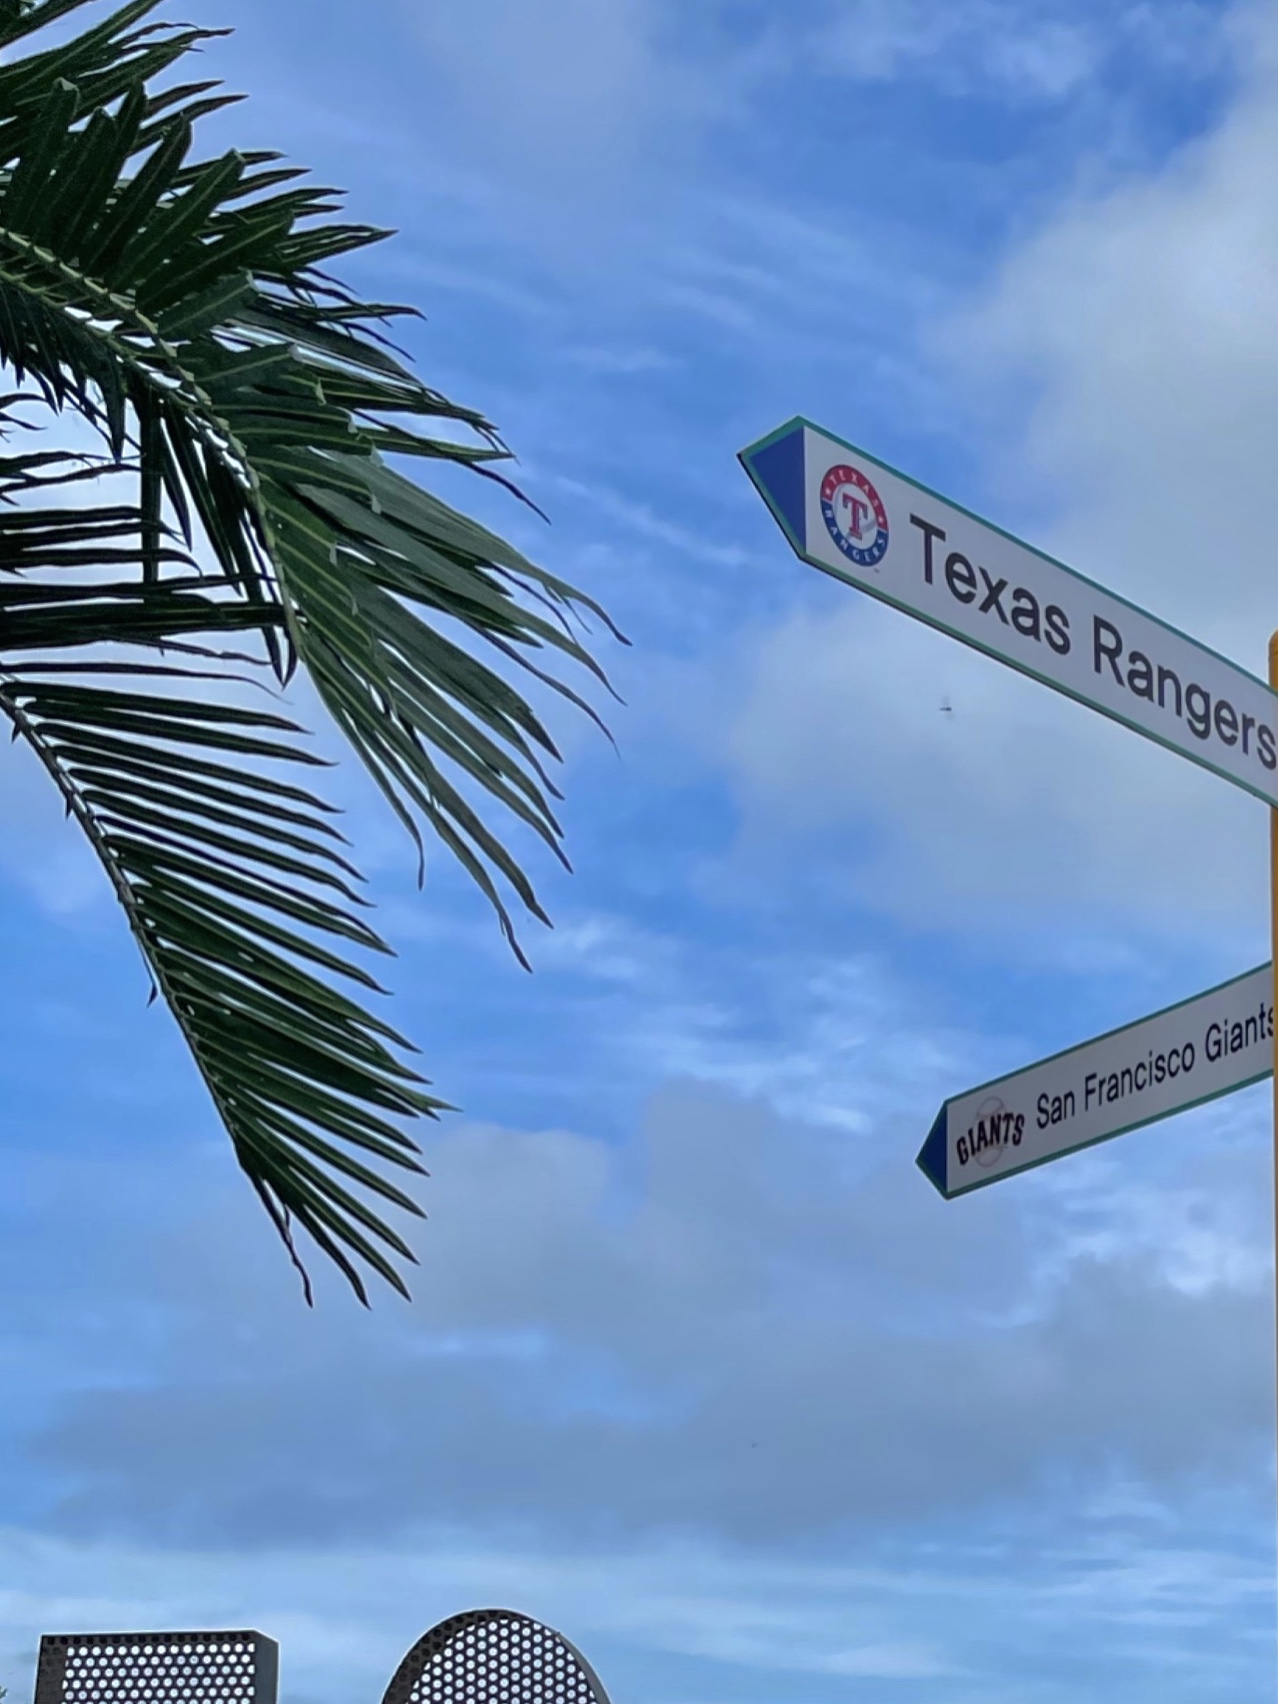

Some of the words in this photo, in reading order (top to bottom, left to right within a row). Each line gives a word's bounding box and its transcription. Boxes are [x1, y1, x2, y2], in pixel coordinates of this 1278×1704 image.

[842, 491, 868, 540] T
[909, 514, 1071, 656] Texas
[1092, 614, 1278, 770] Rangers
[1036, 1091, 1076, 1130] San
[1084, 1042, 1196, 1112] Francisco
[1204, 1001, 1274, 1064] Giants
[956, 1112, 1025, 1166] GIANTS
